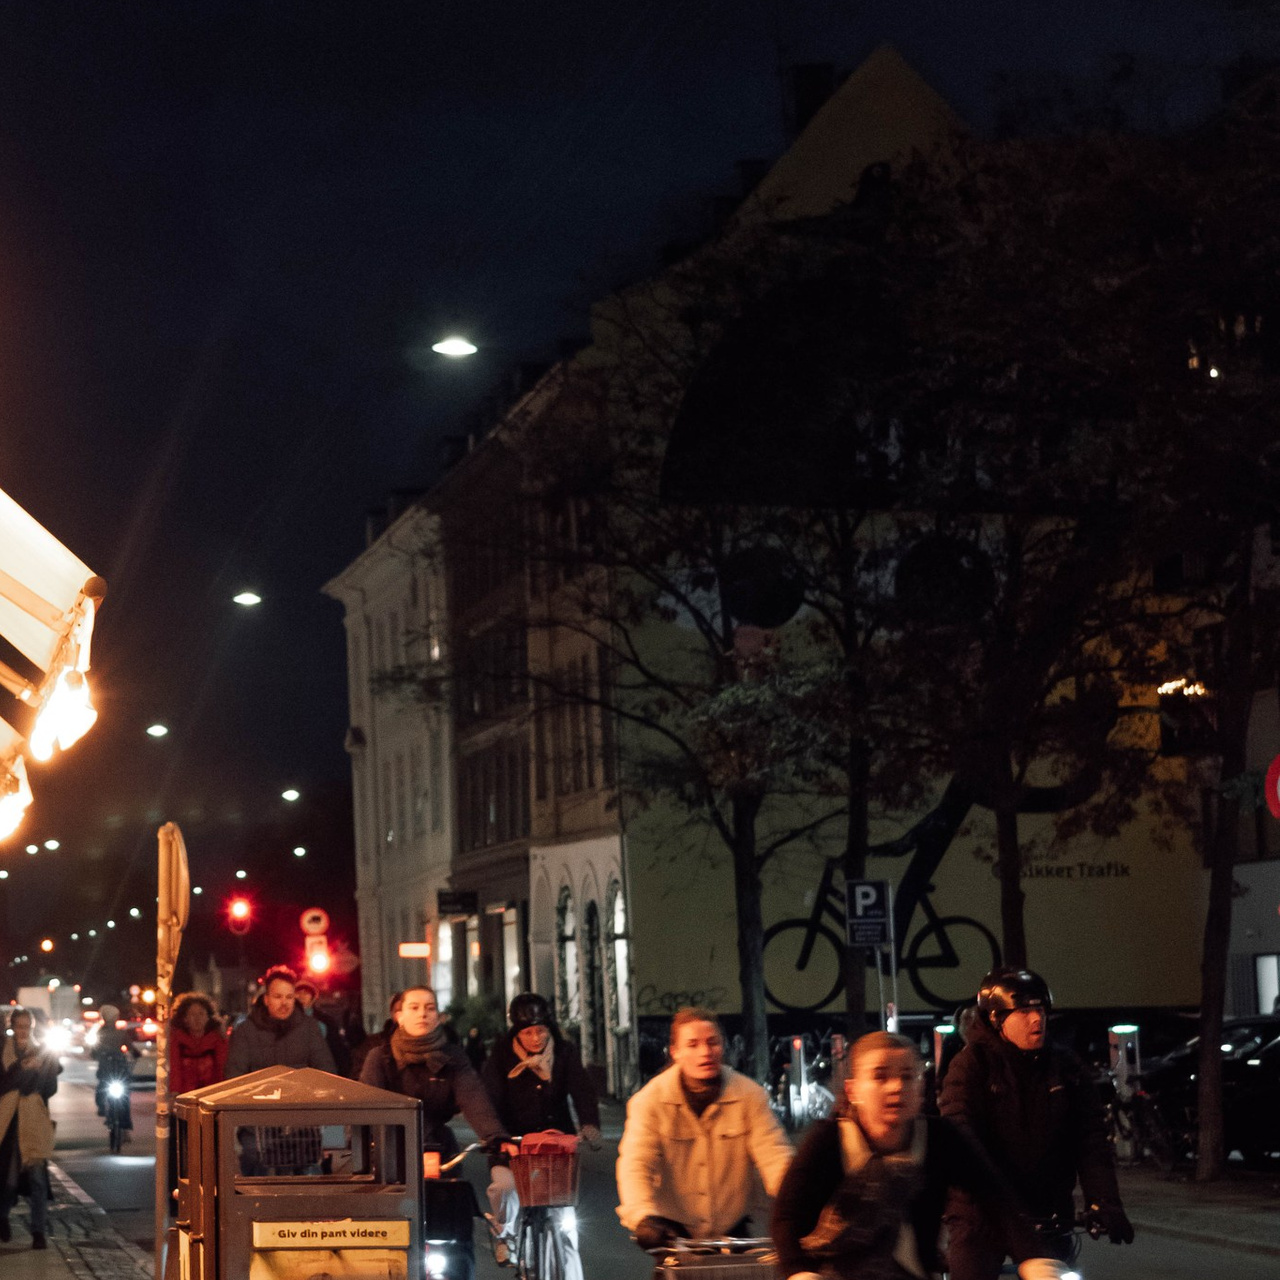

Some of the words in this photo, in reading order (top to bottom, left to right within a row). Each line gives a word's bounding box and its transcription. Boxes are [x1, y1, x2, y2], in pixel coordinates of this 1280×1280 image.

[854, 884, 877, 917] P
[277, 1229, 297, 1238] Giv
[300, 1229, 318, 1238] din
[321, 1229, 347, 1240] pant
[350, 1228, 388, 1238] videre
